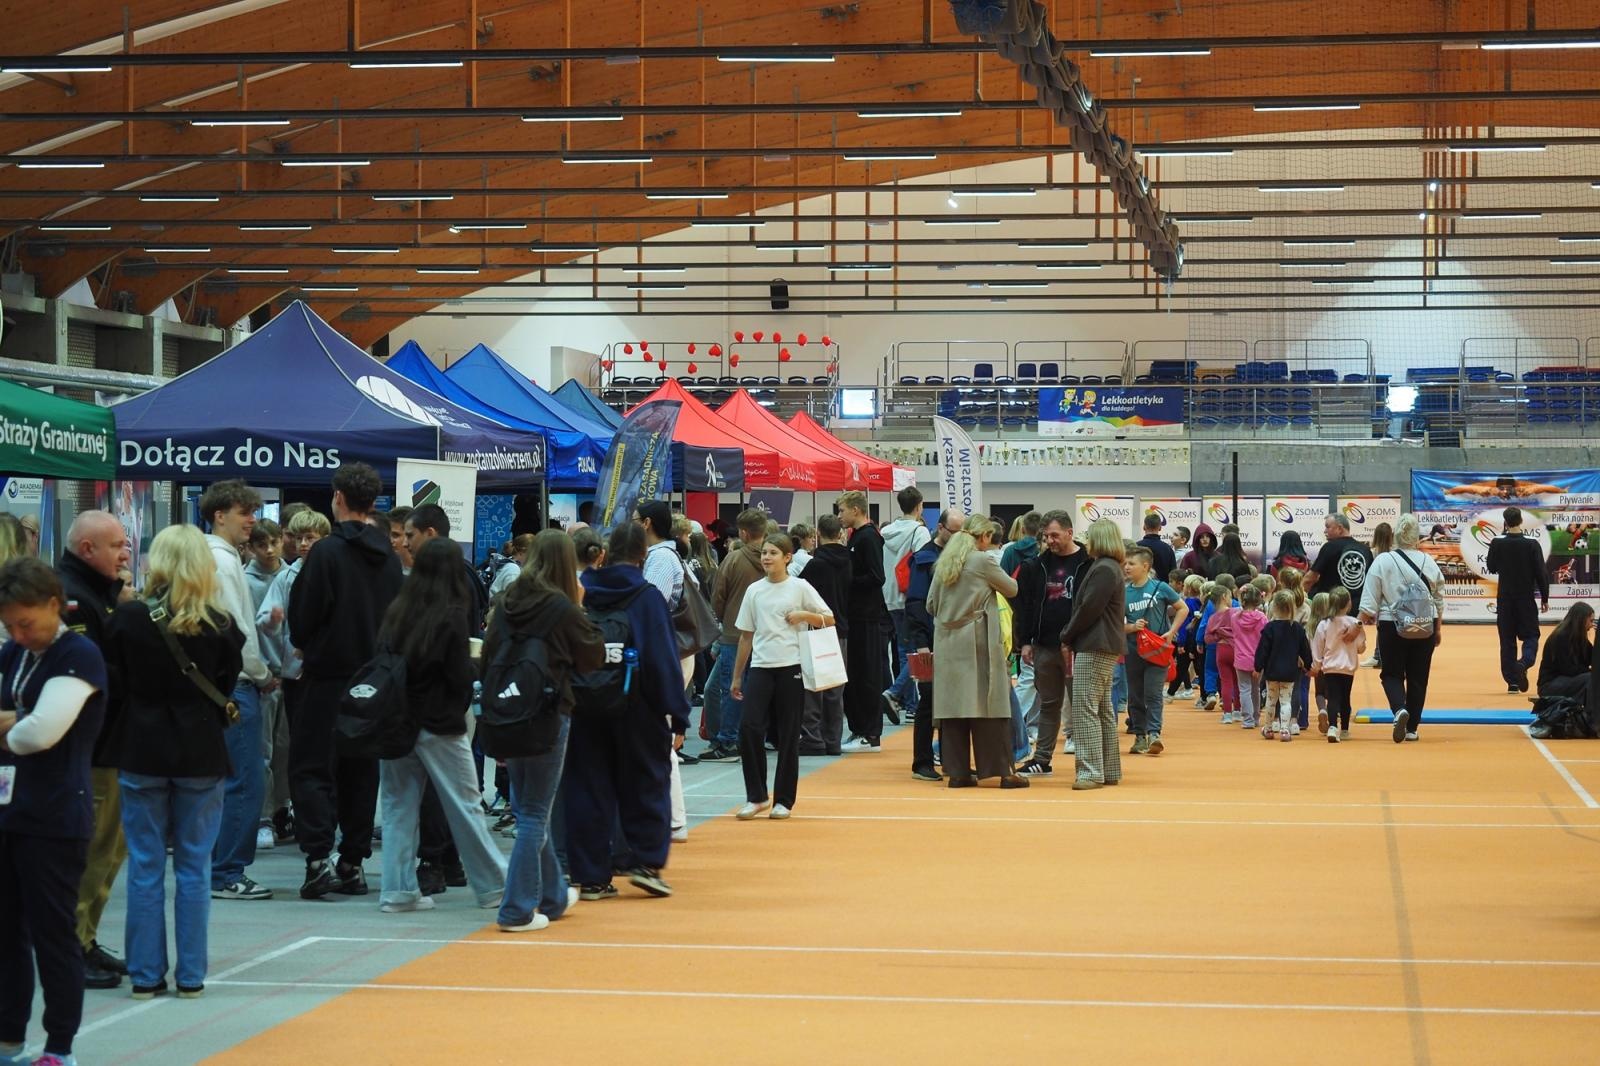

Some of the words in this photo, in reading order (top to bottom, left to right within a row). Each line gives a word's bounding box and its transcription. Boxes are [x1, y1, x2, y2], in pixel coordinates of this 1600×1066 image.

[1101, 395, 1163, 406] Lekkoatletyka
[41, 421, 107, 462] Granicznej
[120, 438, 225, 472] Dołącz
[234, 438, 273, 467] do
[284, 441, 341, 469] Nas
[646, 469, 659, 501] KOWA
[1559, 495, 1594, 507] Pływanie
[1102, 508, 1130, 516] ZSOMS
[1168, 511, 1197, 519] ZSOMS
[1237, 508, 1259, 516] OMS
[1295, 508, 1324, 516] ZSOMS
[1366, 508, 1396, 516] ZSOMS
[1417, 514, 1468, 525] Lekkoatletyka
[1551, 513, 1570, 522] Piłka
[1571, 514, 1594, 523] nożna
[1567, 586, 1593, 598] Zapasy
[1128, 599, 1153, 612] PUMA
